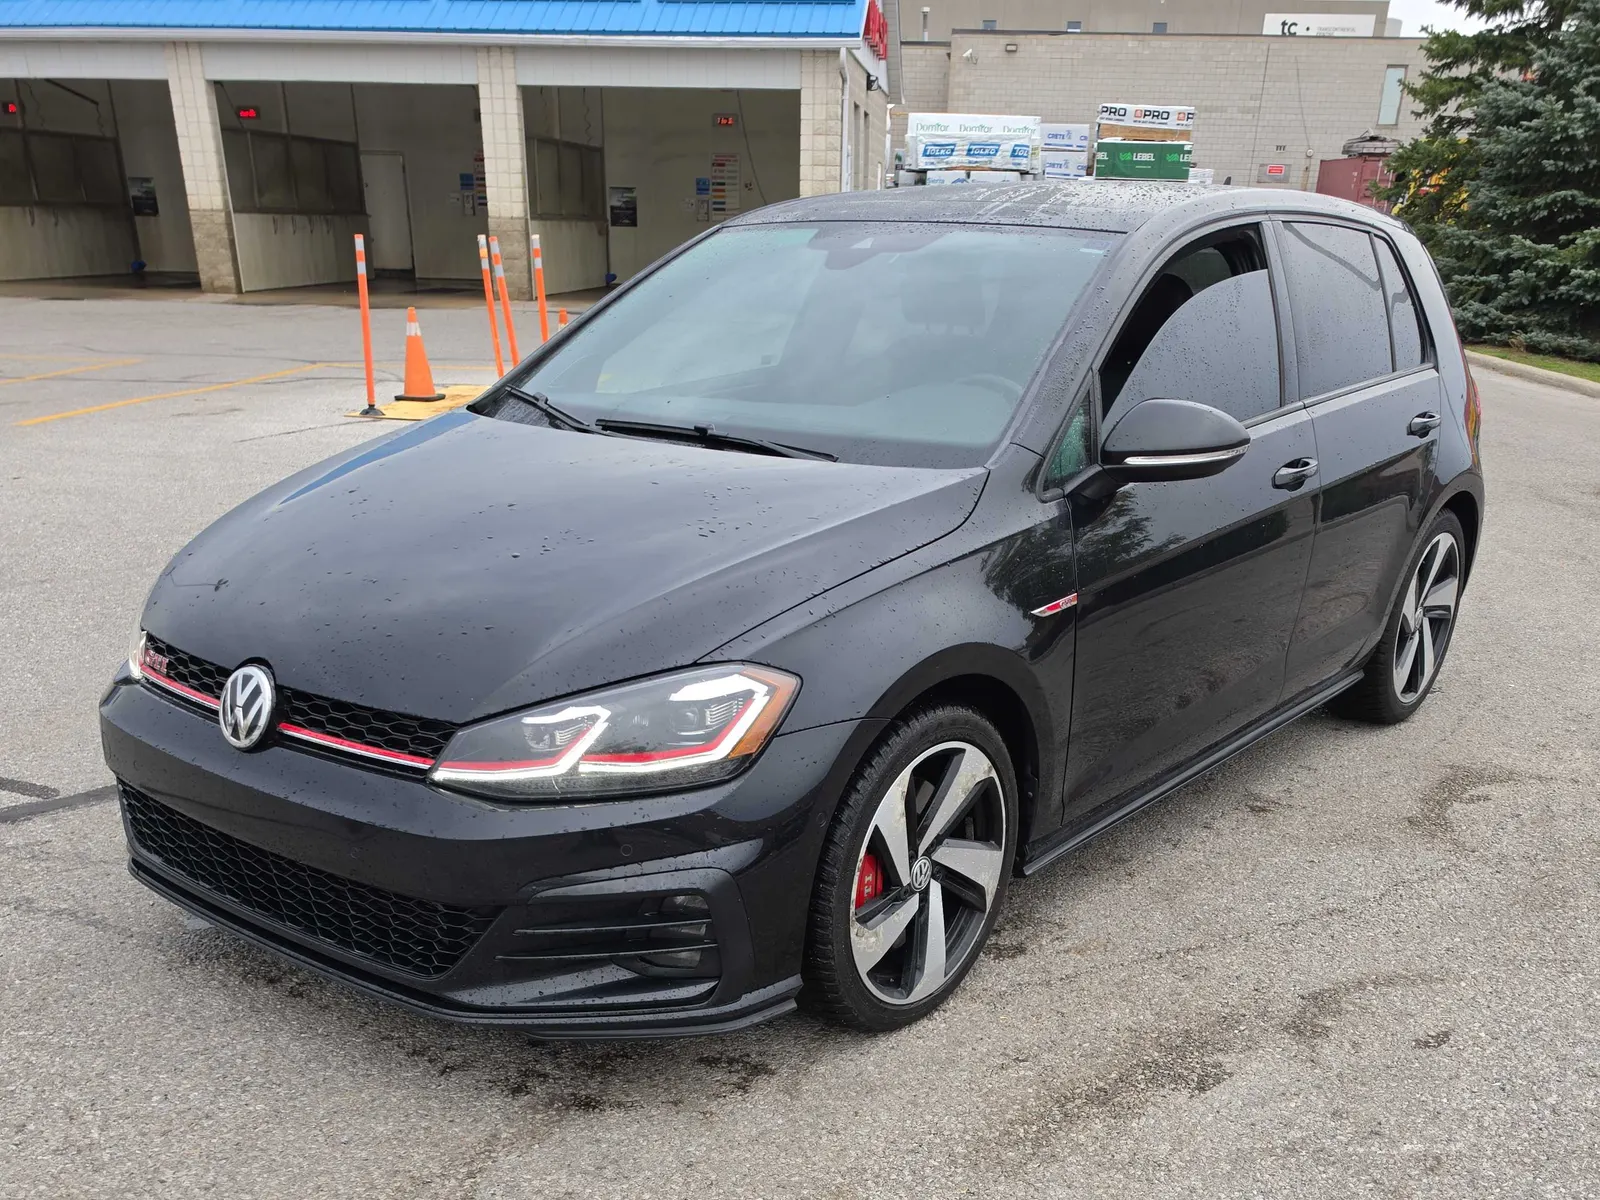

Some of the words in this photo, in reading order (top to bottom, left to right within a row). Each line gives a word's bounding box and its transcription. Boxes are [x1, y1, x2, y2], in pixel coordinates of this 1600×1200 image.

[1281, 20, 1298, 35] tc
[1101, 106, 1126, 116] PRO
[1143, 110, 1170, 120] PRO
[916, 121, 949, 133] Domtar
[959, 124, 992, 134] Domtar
[926, 147, 952, 155] TOLKO
[970, 147, 996, 155] TOLKO
[1133, 152, 1155, 161] LEBEL
